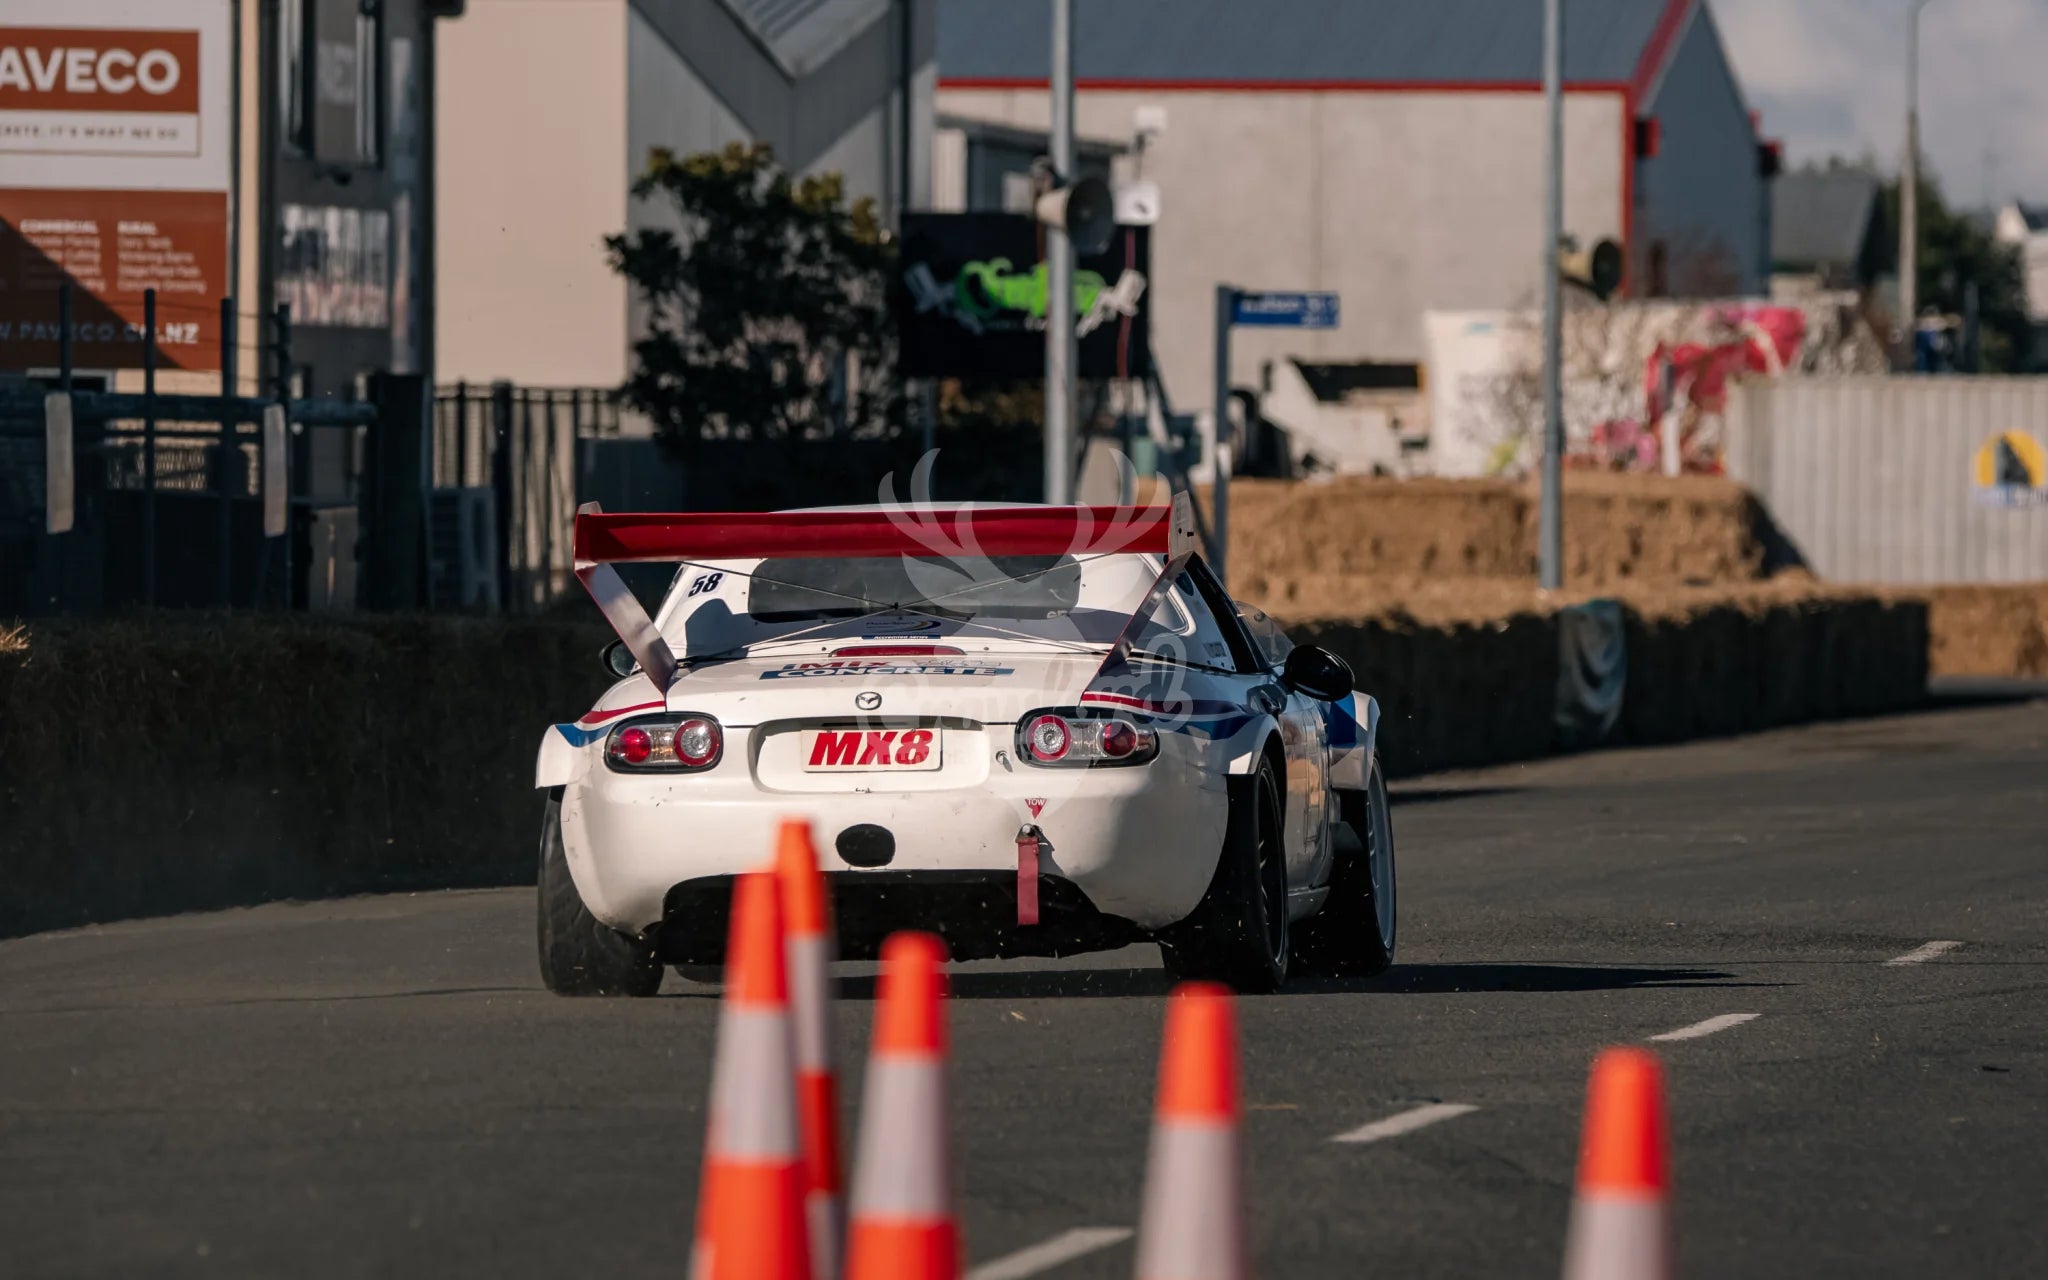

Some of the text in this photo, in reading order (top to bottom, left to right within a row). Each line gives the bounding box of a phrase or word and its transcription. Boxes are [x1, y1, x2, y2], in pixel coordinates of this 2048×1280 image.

[688, 572, 723, 597] 58
[777, 667, 996, 678] CONCRETE
[808, 730, 933, 766] MX8
